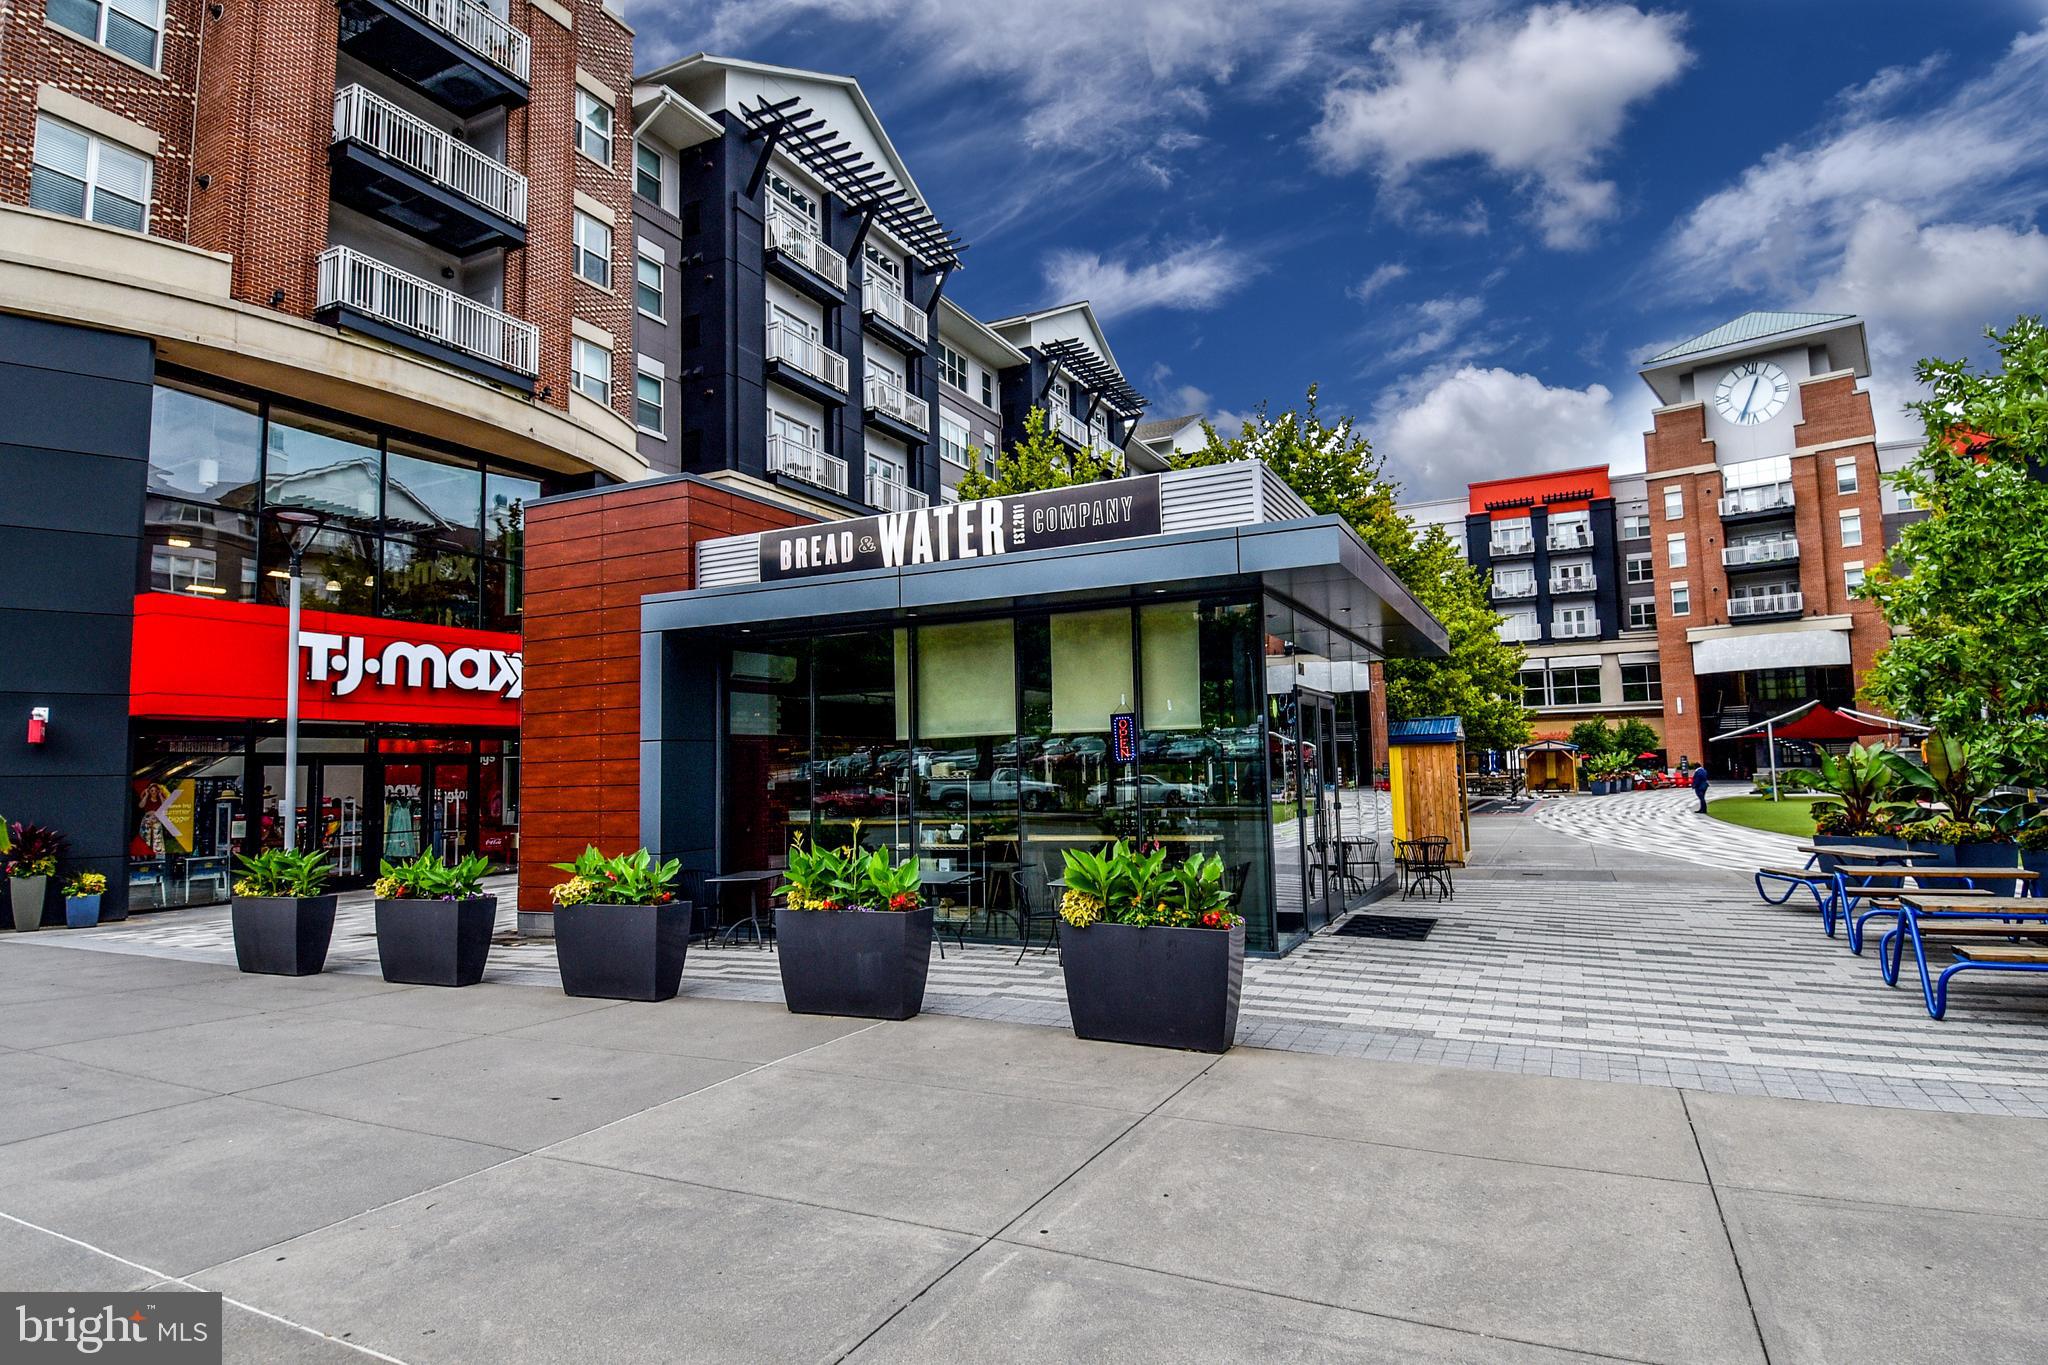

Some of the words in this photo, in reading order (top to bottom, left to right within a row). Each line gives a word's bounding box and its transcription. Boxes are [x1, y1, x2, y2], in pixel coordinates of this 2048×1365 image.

[780, 531, 854, 571] BREAD
[858, 535, 876, 554] &
[878, 498, 1005, 568] WATER
[1032, 496, 1133, 534] COMPANY
[1118, 719, 1129, 759] OPEN
